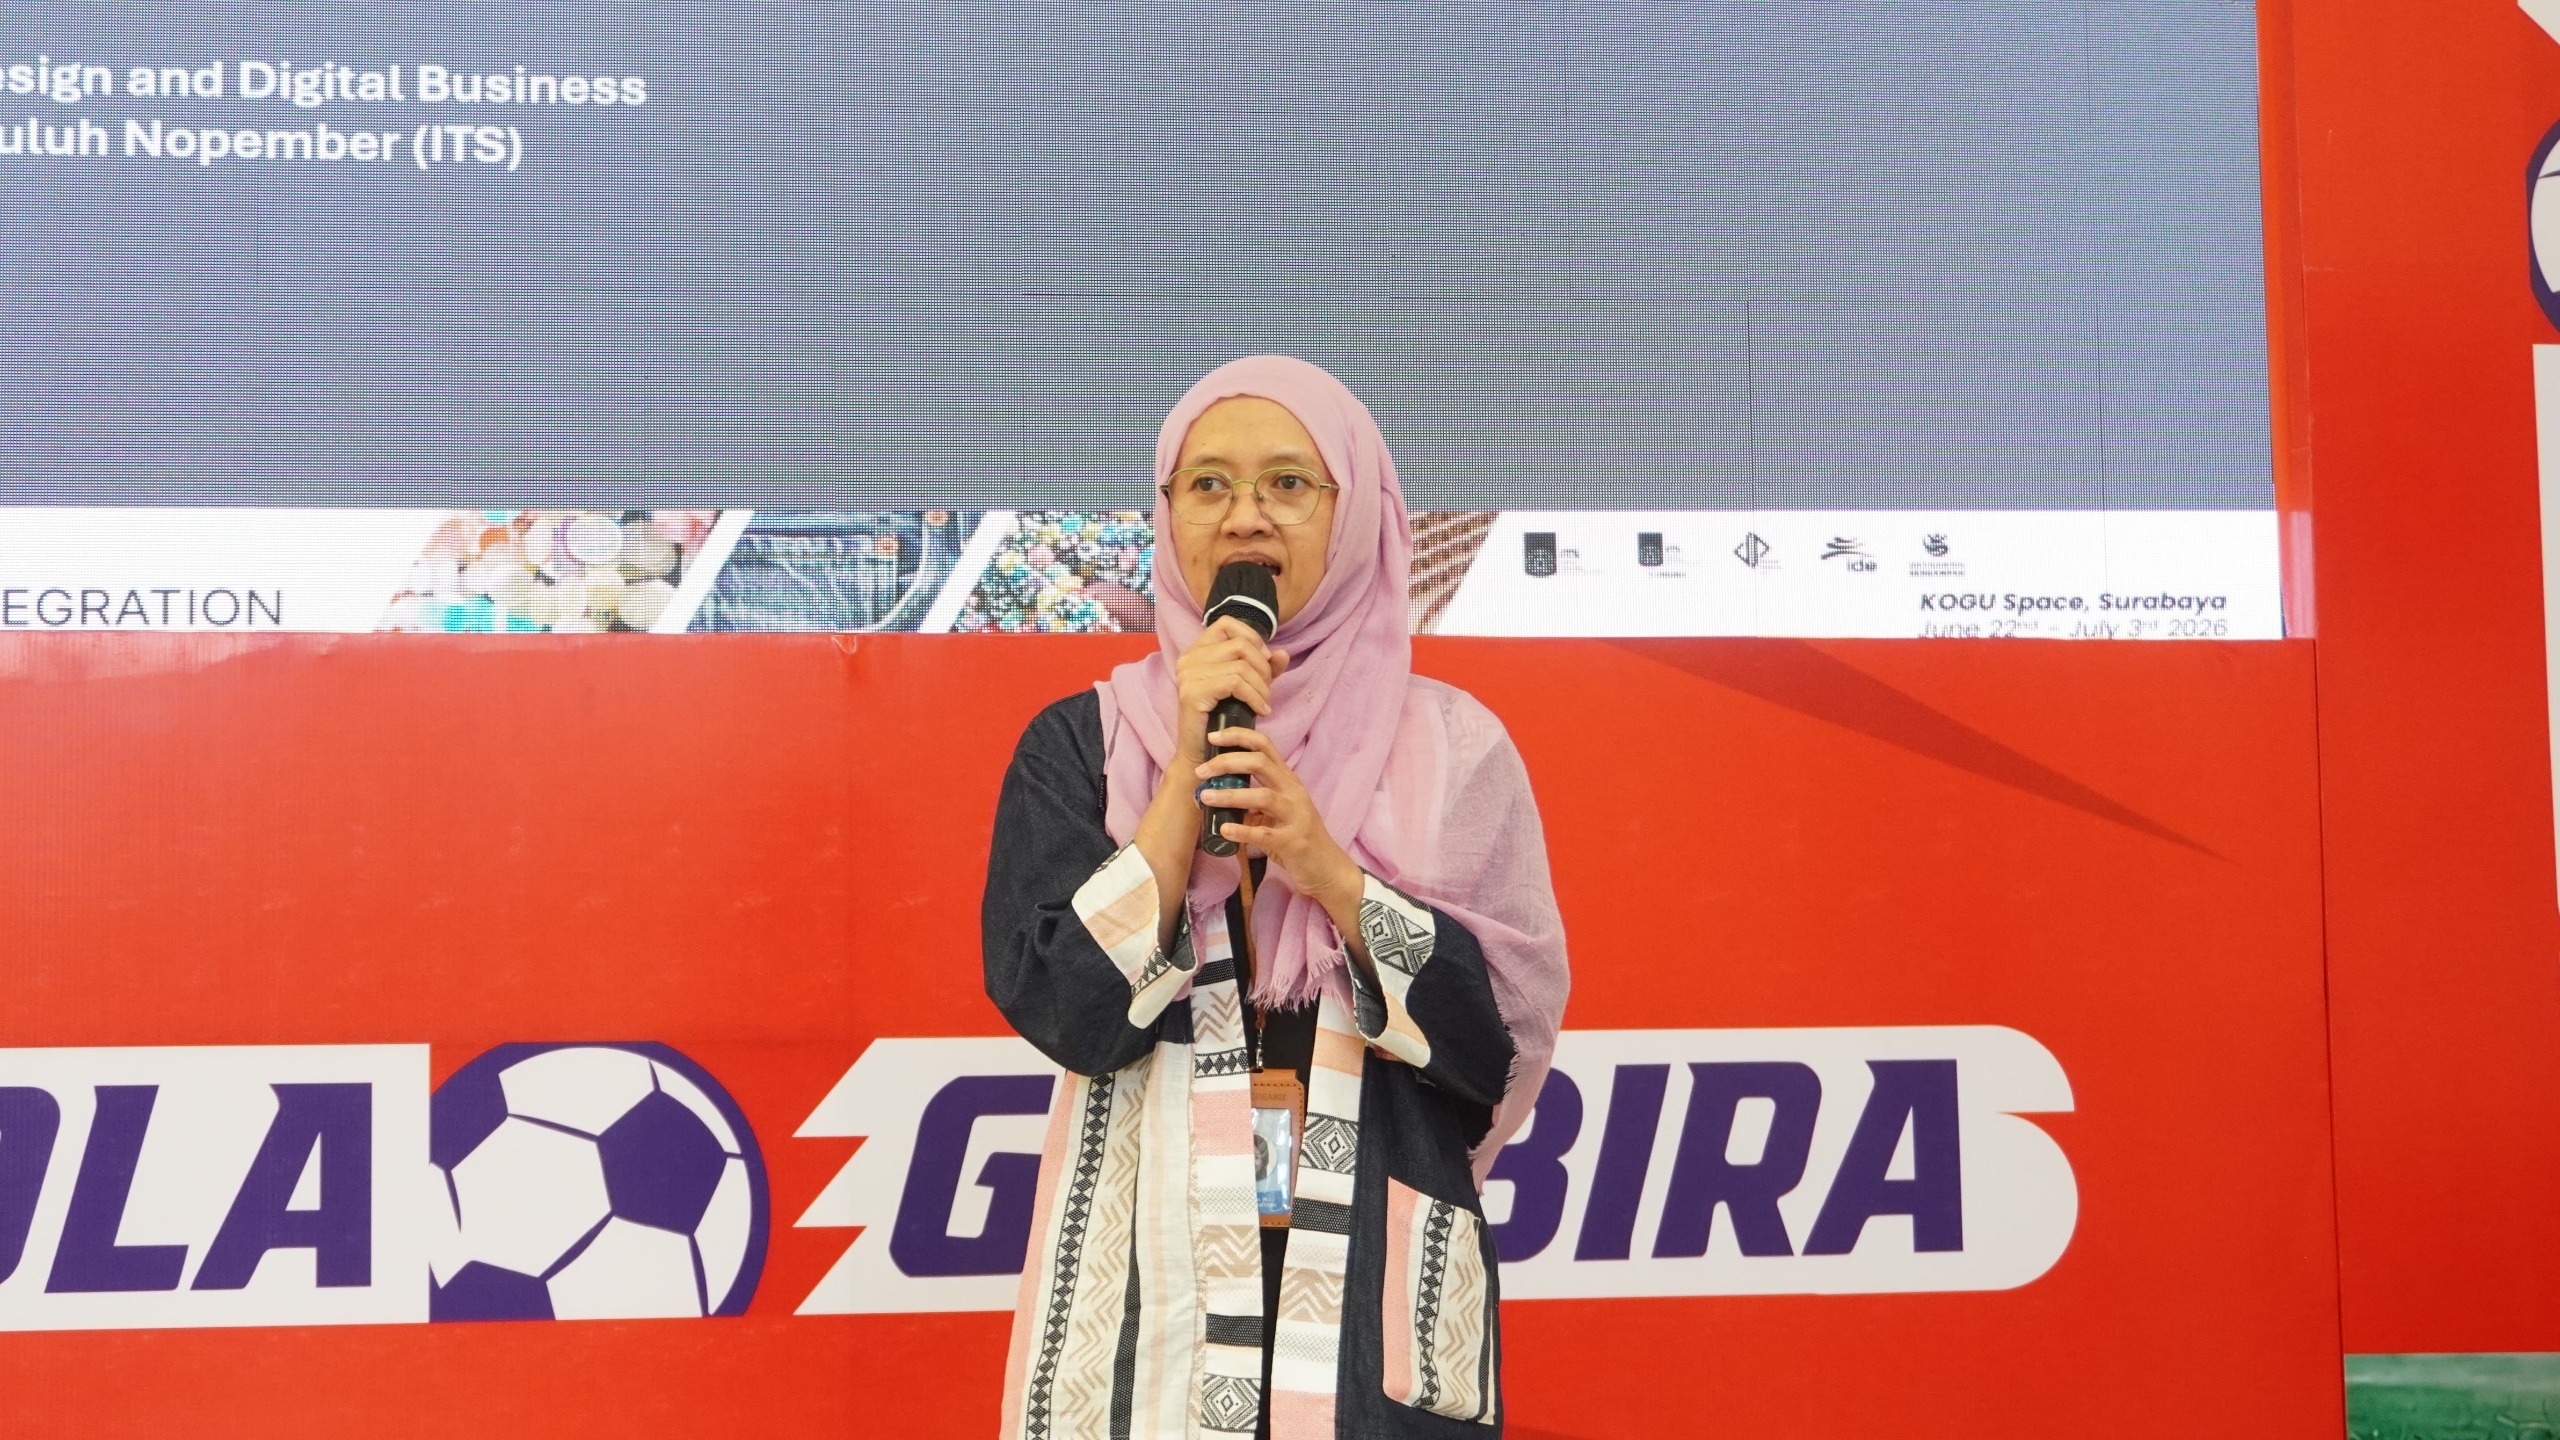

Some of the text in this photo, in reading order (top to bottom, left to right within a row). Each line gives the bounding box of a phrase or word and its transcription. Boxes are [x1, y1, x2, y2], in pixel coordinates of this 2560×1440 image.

[0, 55, 648, 108] sign and Digital Business
[125, 119, 399, 166] Nopember
[413, 124, 522, 170] (ITS)
[2, 588, 282, 627] EGRATION
[1920, 592, 2228, 616] KOGU Space, Surabaya
[1918, 619, 1981, 639] June
[2069, 619, 2120, 640] July
[2167, 619, 2228, 639] 2026
